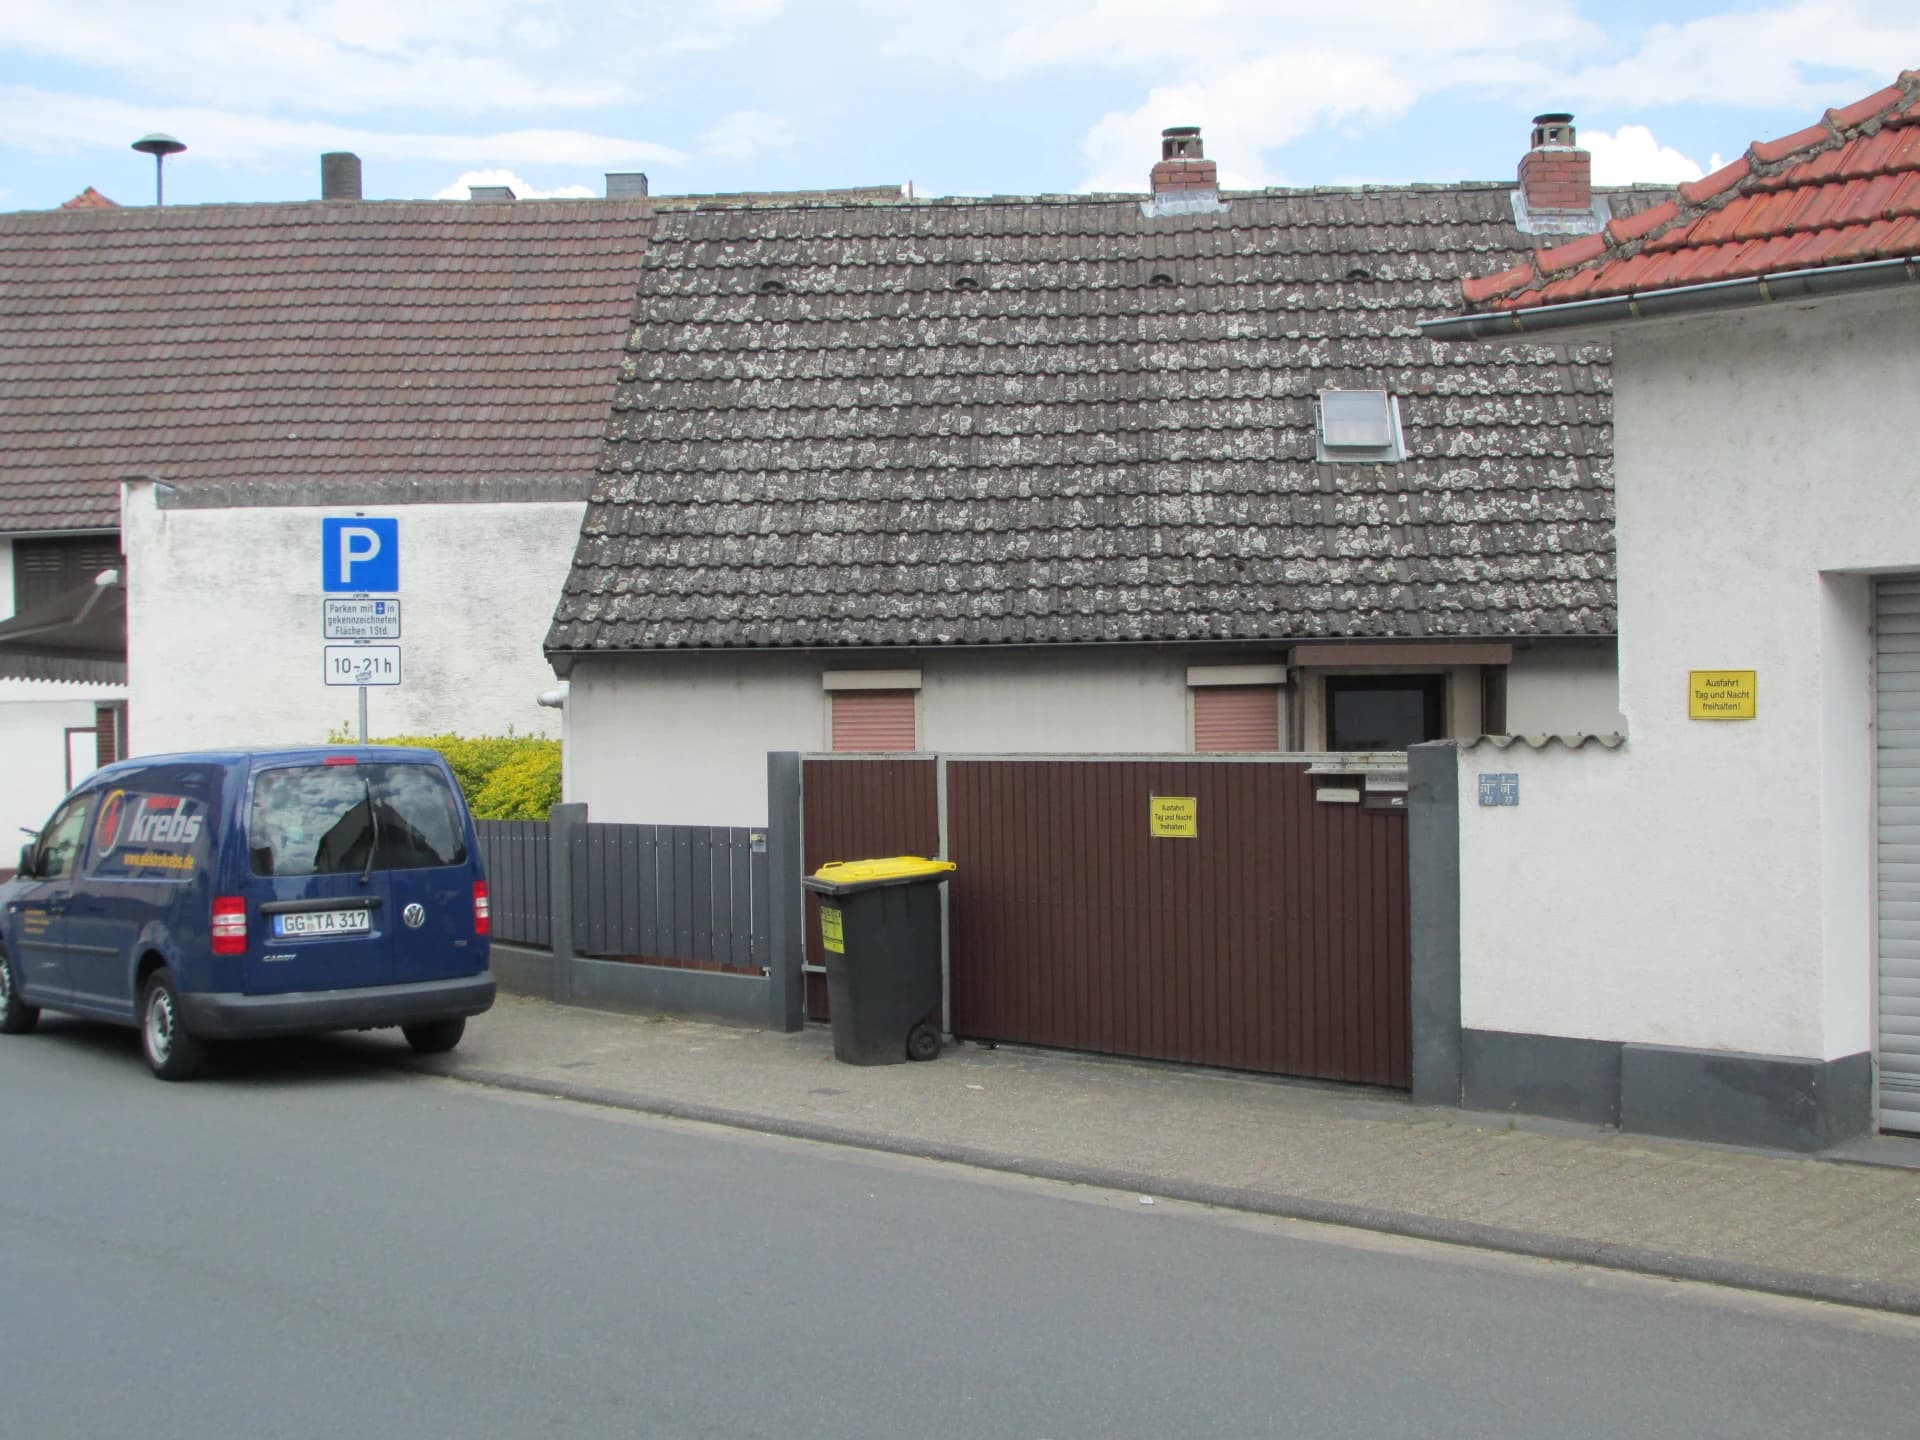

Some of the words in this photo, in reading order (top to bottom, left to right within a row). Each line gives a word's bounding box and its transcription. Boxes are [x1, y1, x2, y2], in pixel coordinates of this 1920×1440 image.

[340, 527, 381, 583] P
[329, 603, 357, 613] Parken
[360, 603, 373, 613] mit
[387, 603, 395, 613] in
[327, 616, 397, 627] gekennzeichneten
[335, 625, 366, 636] Flächen
[1705, 679, 1739, 687] Ausfahrt
[1695, 690, 1709, 700] Tag
[1710, 690, 1725, 699] und
[1726, 690, 1750, 699] Nacht
[1702, 702, 1740, 711] freihalten!
[128, 798, 203, 843] krebs
[1154, 813, 1164, 822] Tag
[284, 916, 306, 932] GG
[315, 914, 335, 930] TA
[339, 912, 366, 928] 317
